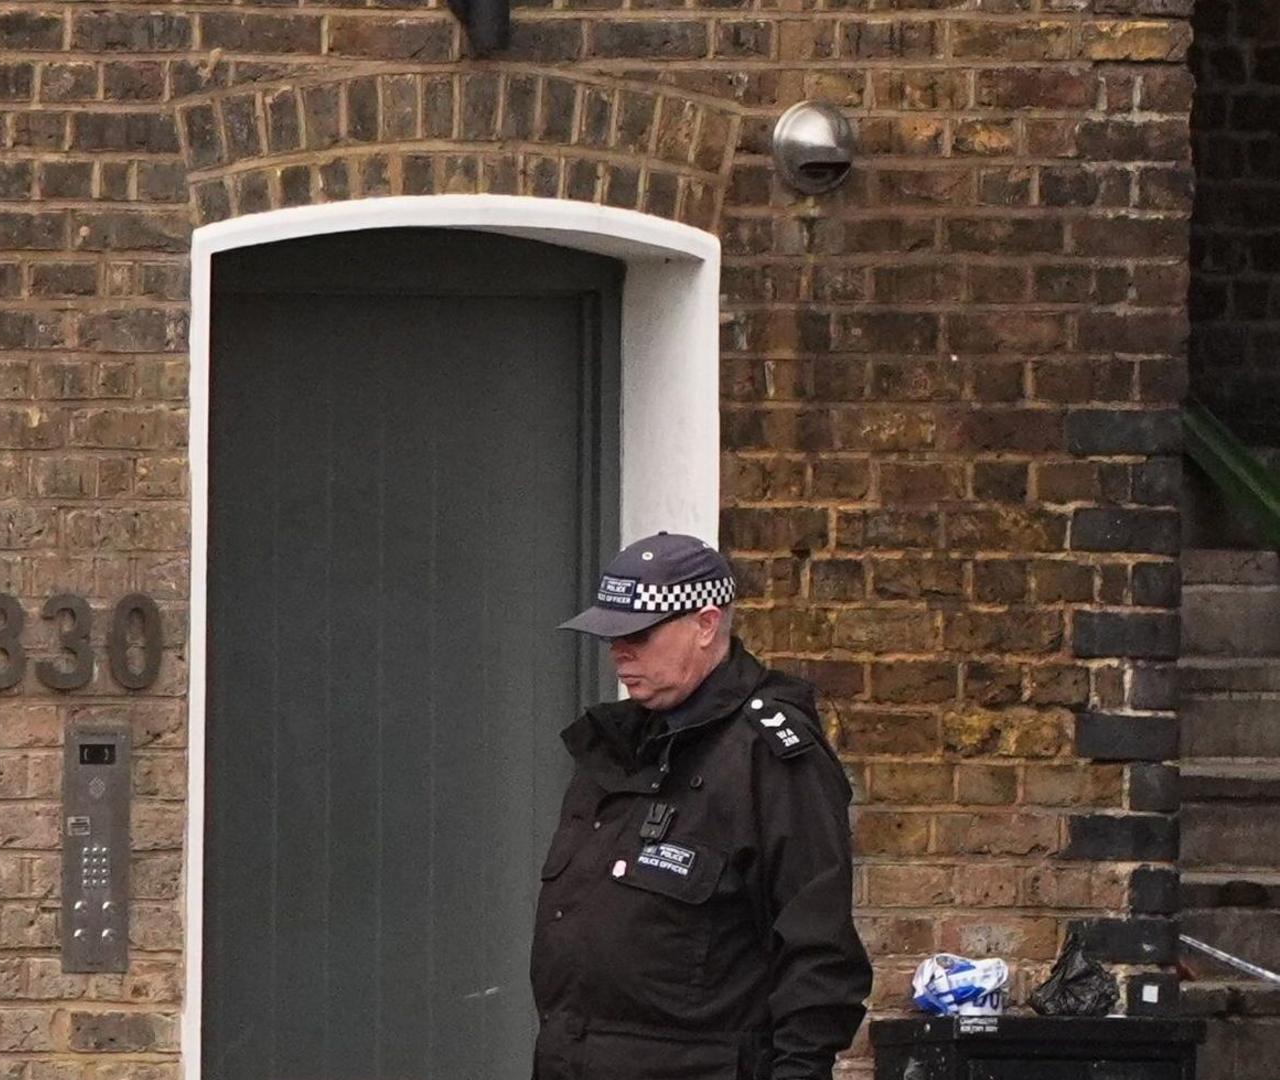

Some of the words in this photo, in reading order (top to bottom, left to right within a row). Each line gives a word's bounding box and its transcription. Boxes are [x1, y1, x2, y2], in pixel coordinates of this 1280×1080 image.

[607, 584, 626, 593] POLICE
[605, 595, 631, 604] OFFICER
[776, 728, 794, 740] WA
[660, 850, 684, 863] POLICE
[638, 856, 660, 868] POLICE
[659, 860, 689, 876] OFFICER
